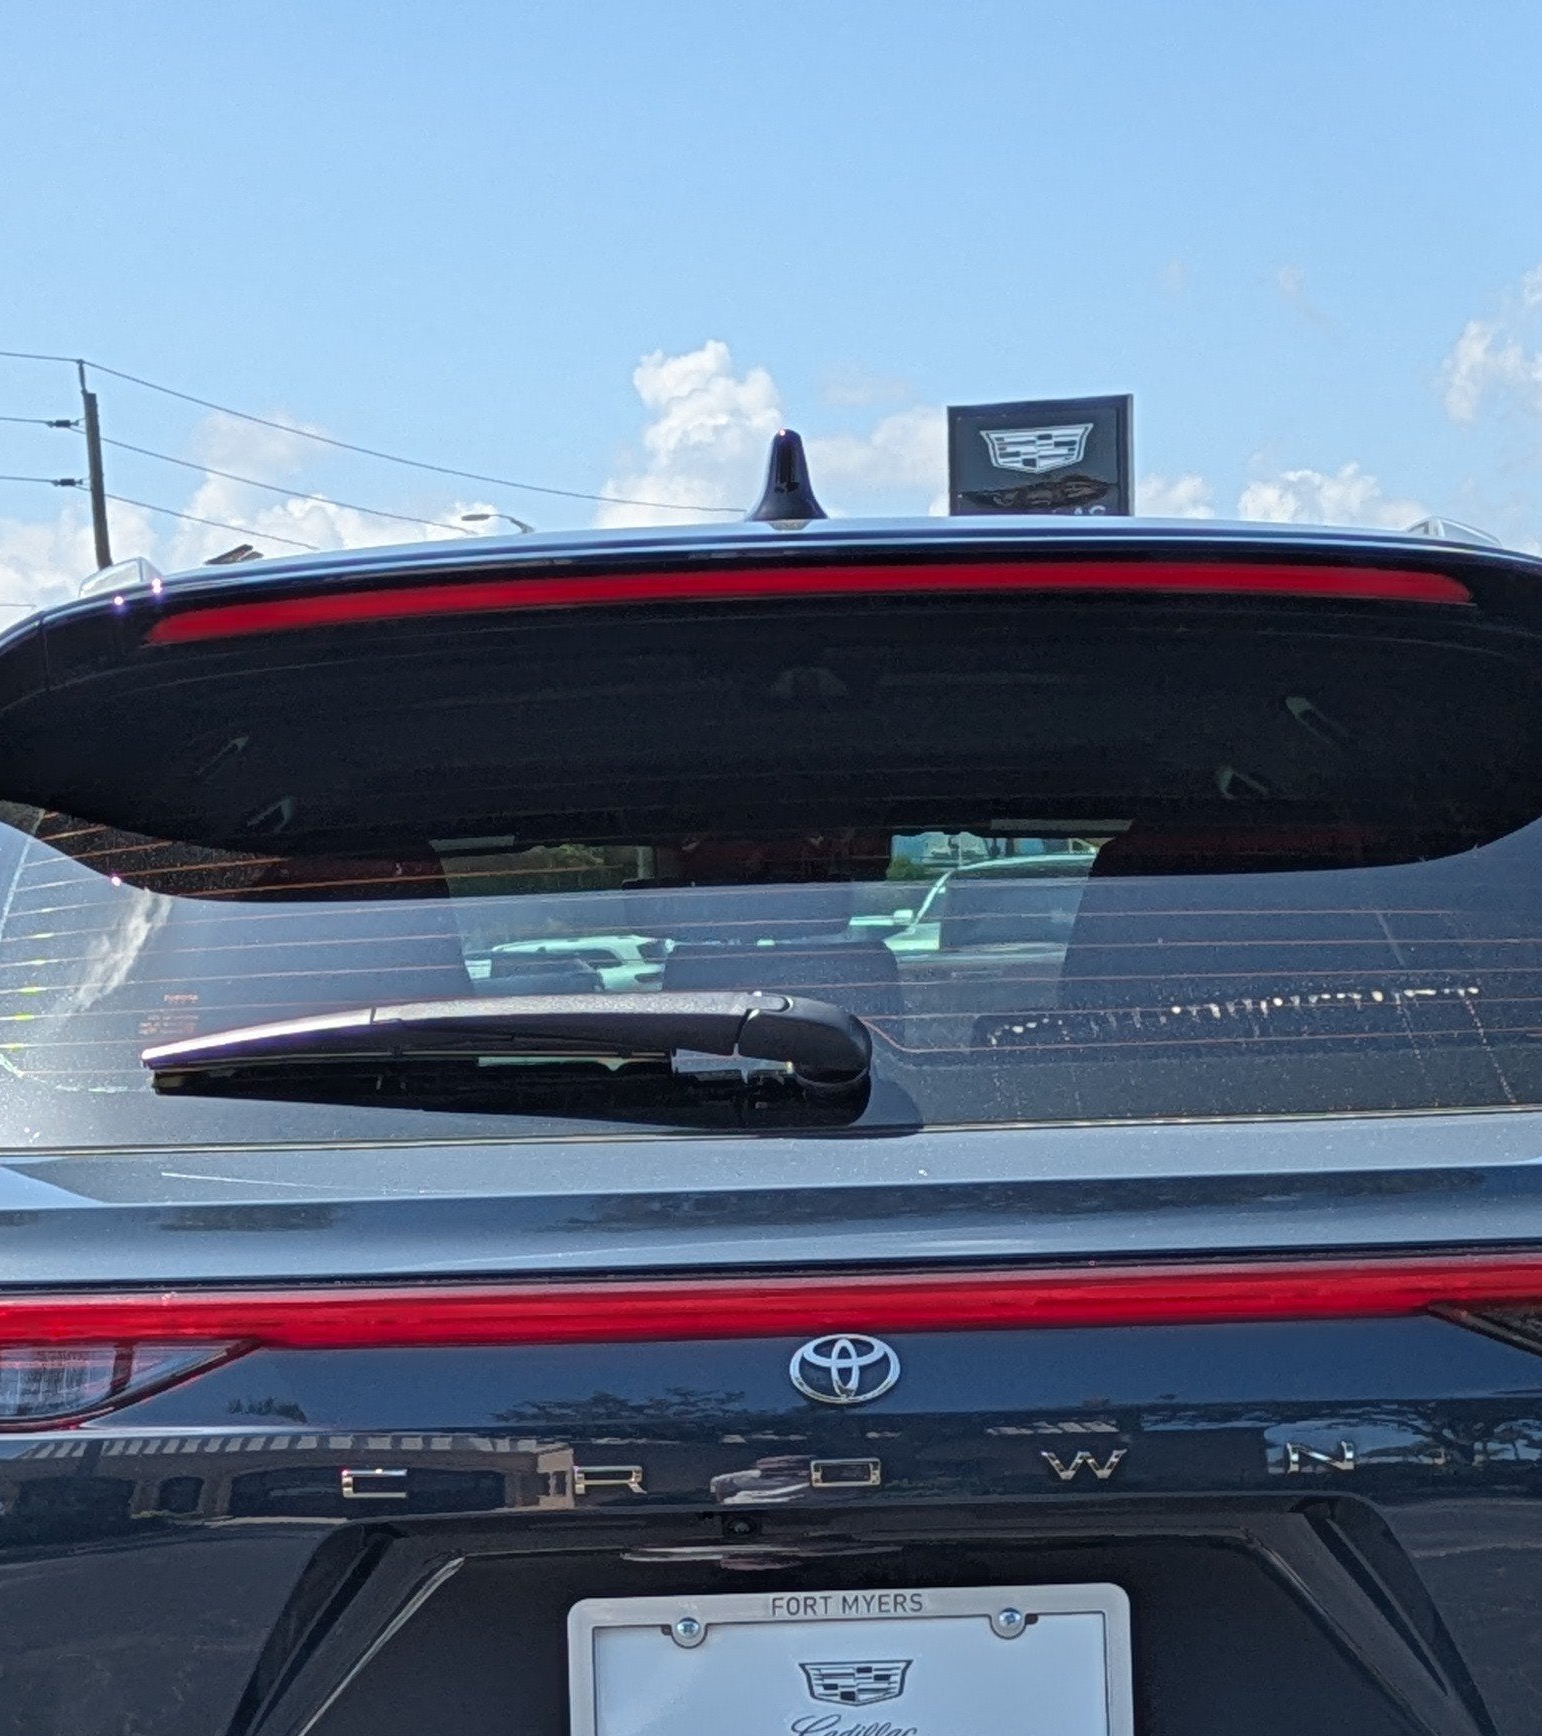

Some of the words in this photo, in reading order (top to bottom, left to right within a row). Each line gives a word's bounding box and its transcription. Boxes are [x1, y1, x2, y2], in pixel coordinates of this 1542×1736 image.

[341, 1436, 1356, 1500] CROWN
[771, 1596, 832, 1617] FORT
[842, 1593, 924, 1614] MYERS
